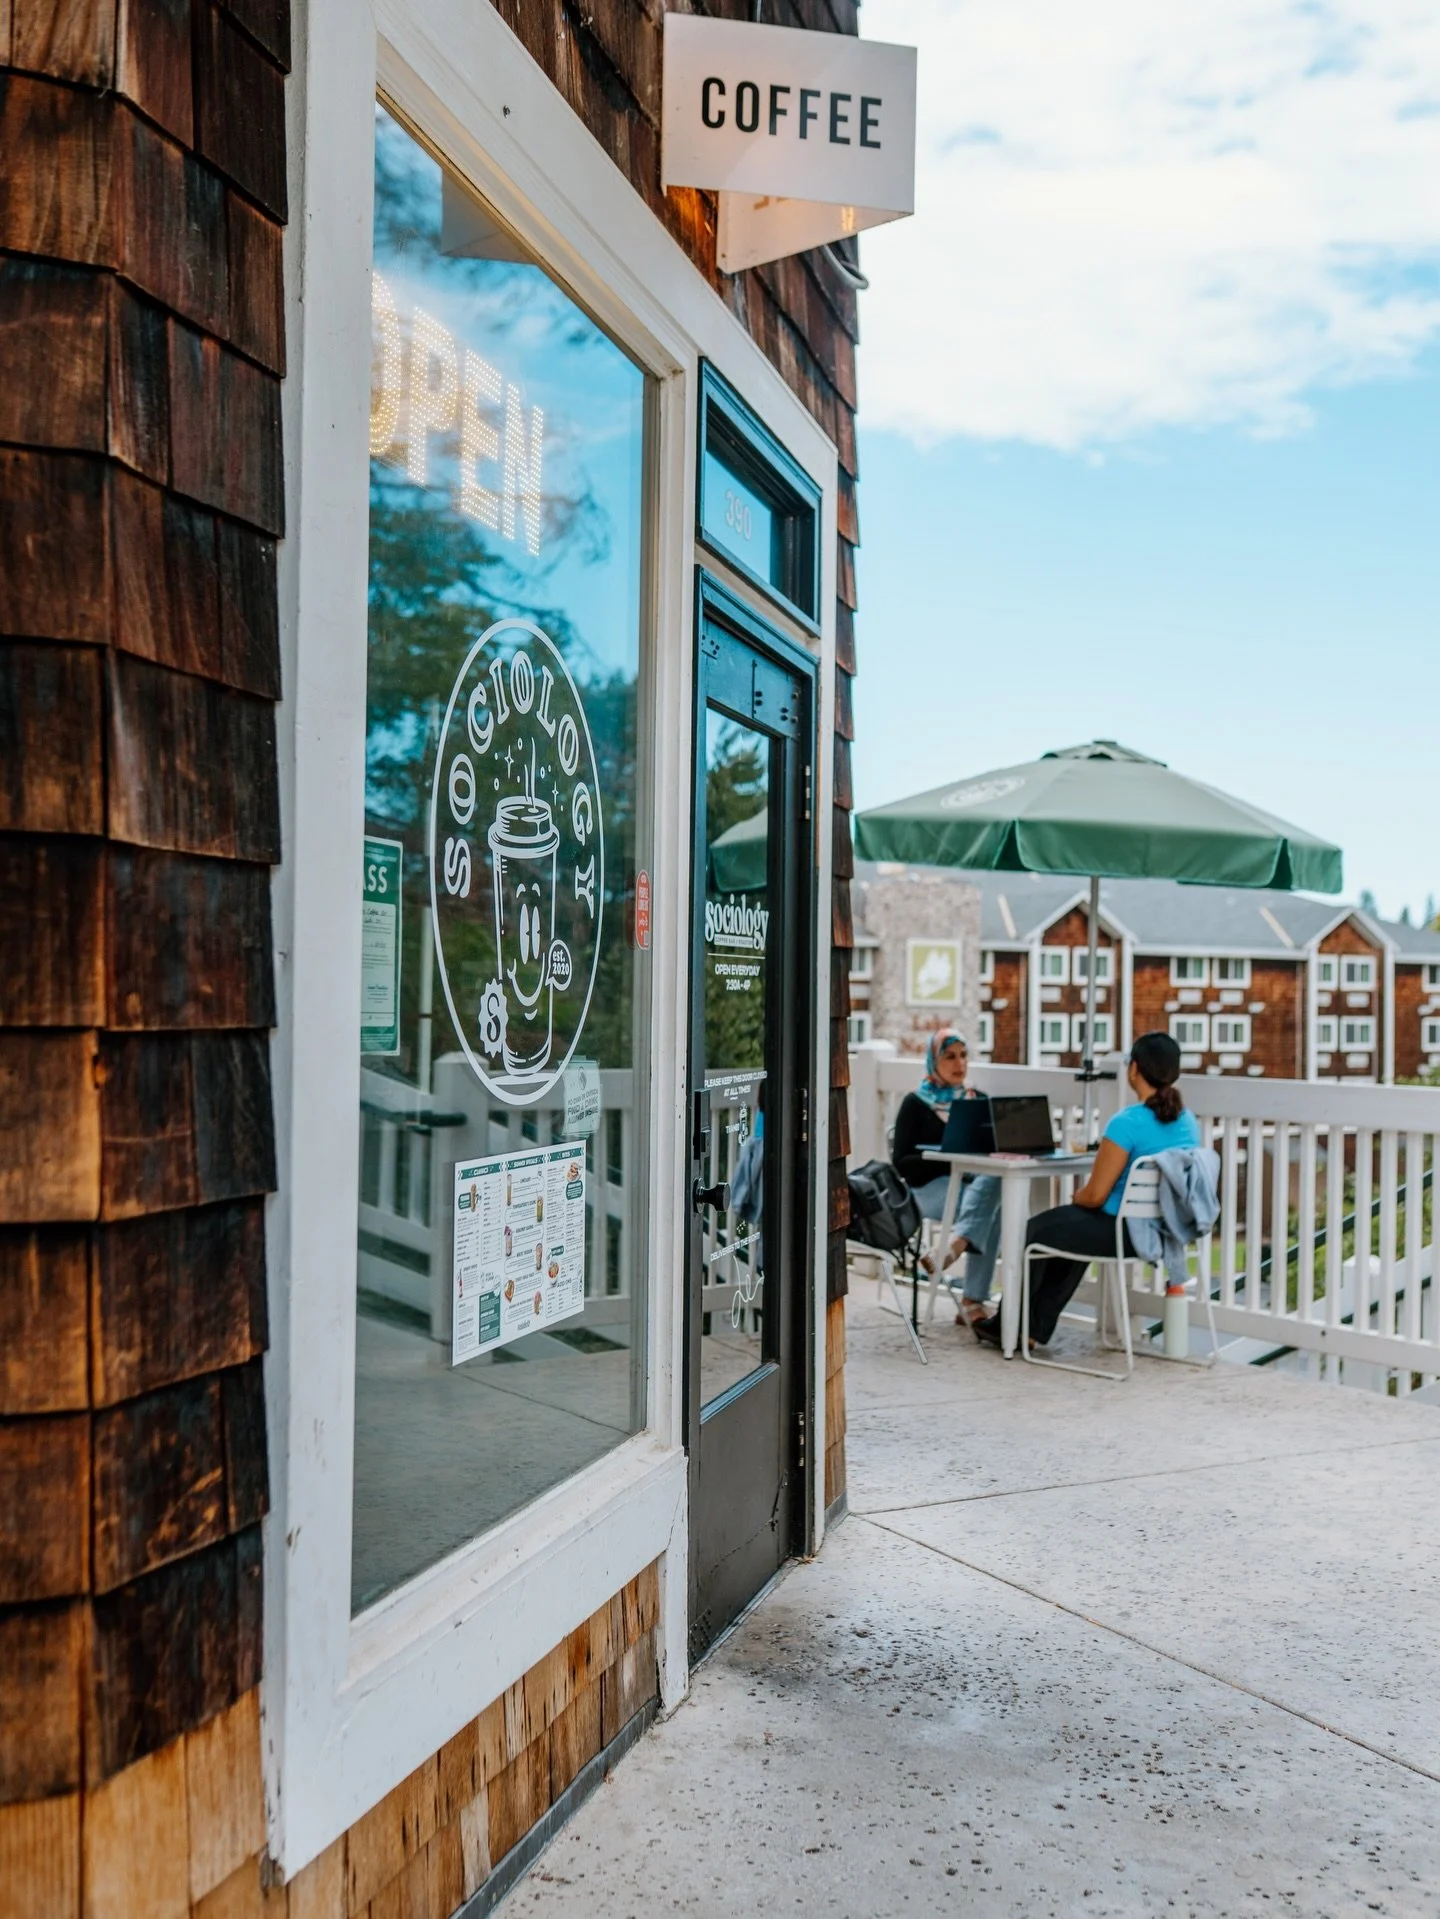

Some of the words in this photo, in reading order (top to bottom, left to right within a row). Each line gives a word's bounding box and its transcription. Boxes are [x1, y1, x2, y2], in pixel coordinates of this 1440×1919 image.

[701, 76, 882, 149] COFFEE
[369, 270, 544, 558] OPEN
[725, 489, 752, 541] 390
[444, 650, 596, 920] SOCIOLOGY
[364, 864, 387, 894] SS
[552, 949, 565, 962] est.
[552, 963, 570, 976] 2020
[715, 964, 730, 975] OPEN
[704, 1077, 721, 1089] PLEASE
